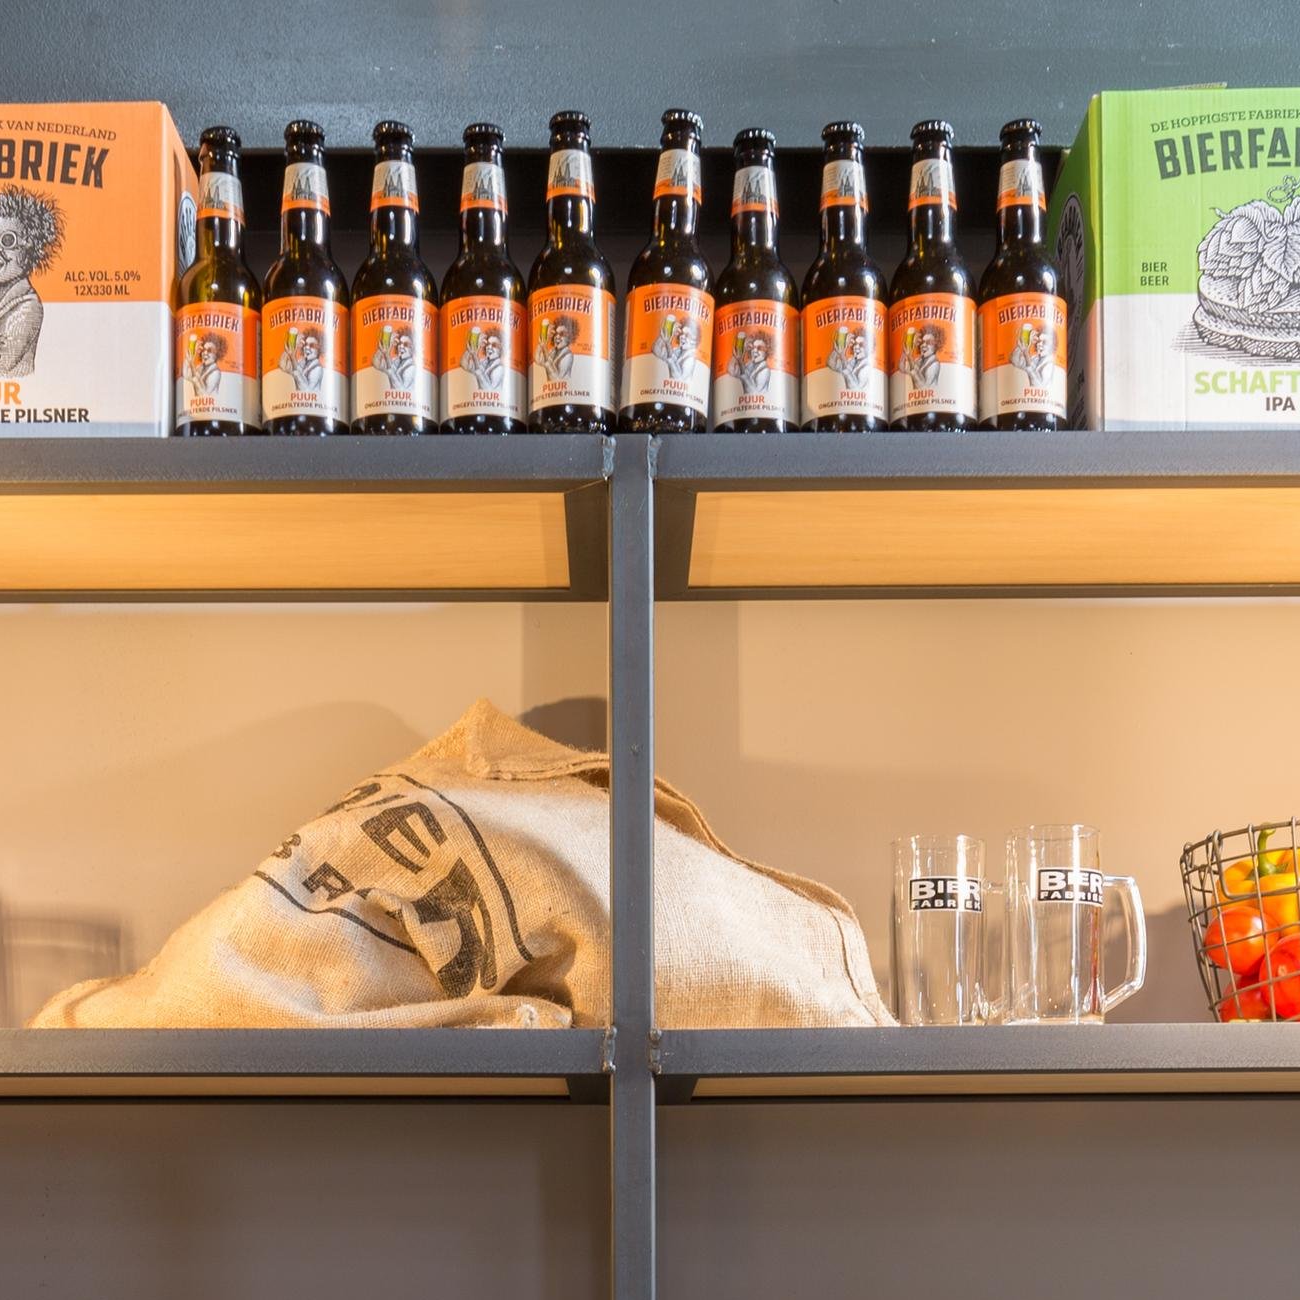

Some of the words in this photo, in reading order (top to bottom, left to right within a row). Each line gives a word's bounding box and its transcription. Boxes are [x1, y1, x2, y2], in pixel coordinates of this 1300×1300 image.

[1150, 121, 1169, 133] DE
[1171, 110, 1246, 130] HOPPIGSTE
[7, 121, 34, 130] VAN
[36, 122, 117, 142] NEDERLAND
[1141, 262, 1168, 273] BIER
[114, 270, 141, 282] 5.0%
[1140, 276, 1170, 286] BEER
[74, 285, 112, 296] 12X330
[114, 284, 130, 296] ML
[542, 381, 568, 392] PUUR
[290, 392, 317, 401] PUUR
[384, 391, 412, 401] PUUR
[472, 392, 500, 401] PUUR
[564, 390, 590, 398] PILSNER
[738, 394, 765, 405] PUUR
[840, 391, 866, 401] PUUR
[908, 389, 934, 400] PUUR
[190, 398, 216, 407] PUUR
[1265, 397, 1296, 412] IPA
[212, 406, 238, 414] PILSNER
[15, 408, 90, 424] PILSNER
[911, 878, 981, 900] BIER
